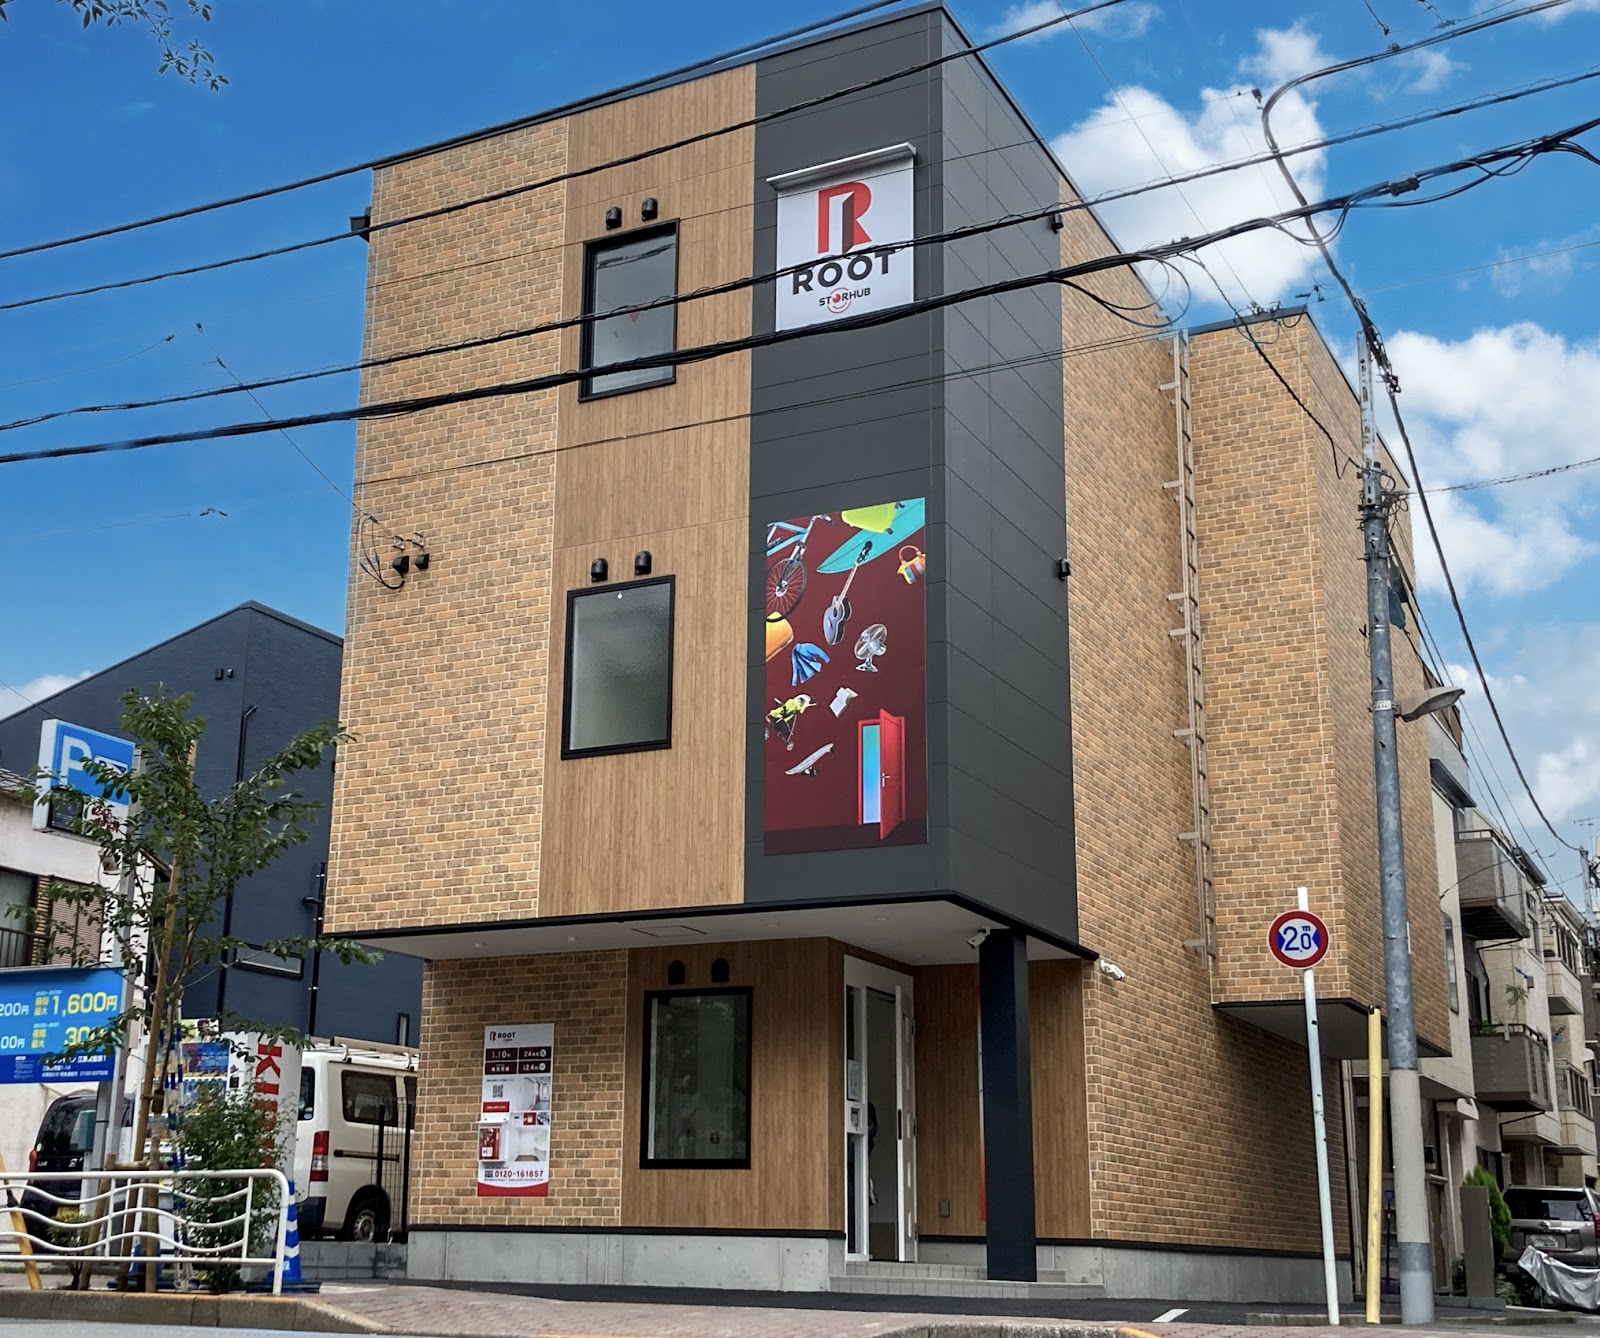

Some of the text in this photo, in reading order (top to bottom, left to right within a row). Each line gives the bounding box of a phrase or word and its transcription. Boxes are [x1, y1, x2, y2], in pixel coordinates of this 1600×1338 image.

[792, 249, 896, 295] ROOT
[818, 287, 871, 307] STORHUB
[59, 735, 92, 786] P
[53, 992, 118, 1017] 1,600円
[494, 1170, 544, 1178] 0120-161857
